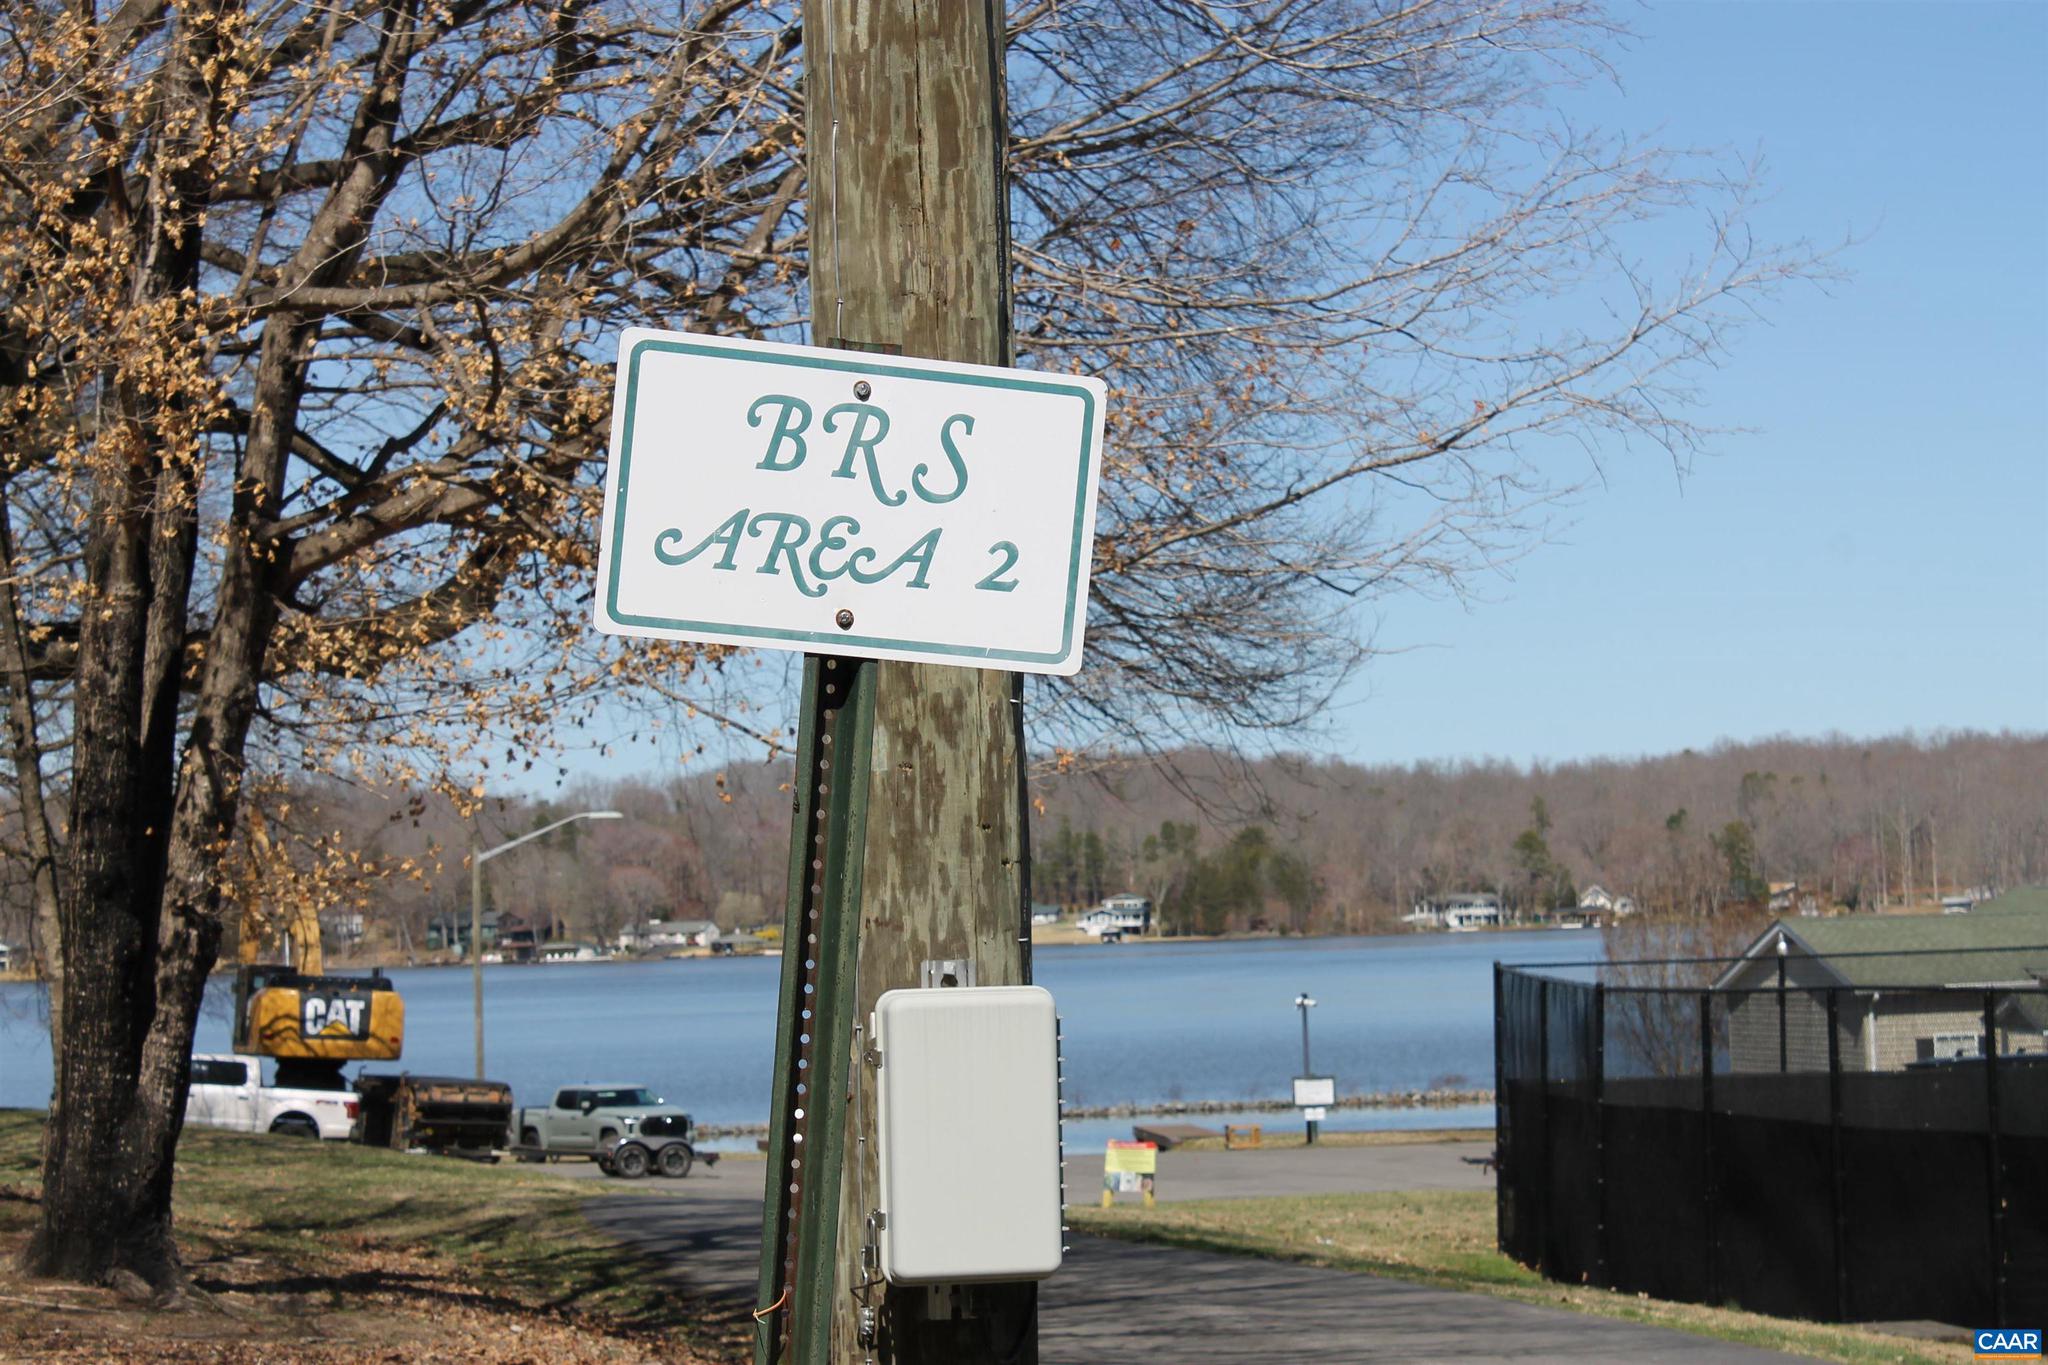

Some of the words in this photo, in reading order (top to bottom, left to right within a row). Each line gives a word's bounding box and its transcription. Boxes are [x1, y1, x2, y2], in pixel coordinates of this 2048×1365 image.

[746, 393, 976, 507] BRS
[653, 507, 944, 598] AREA
[974, 540, 1021, 593] 2
[305, 997, 366, 1036] CAT
